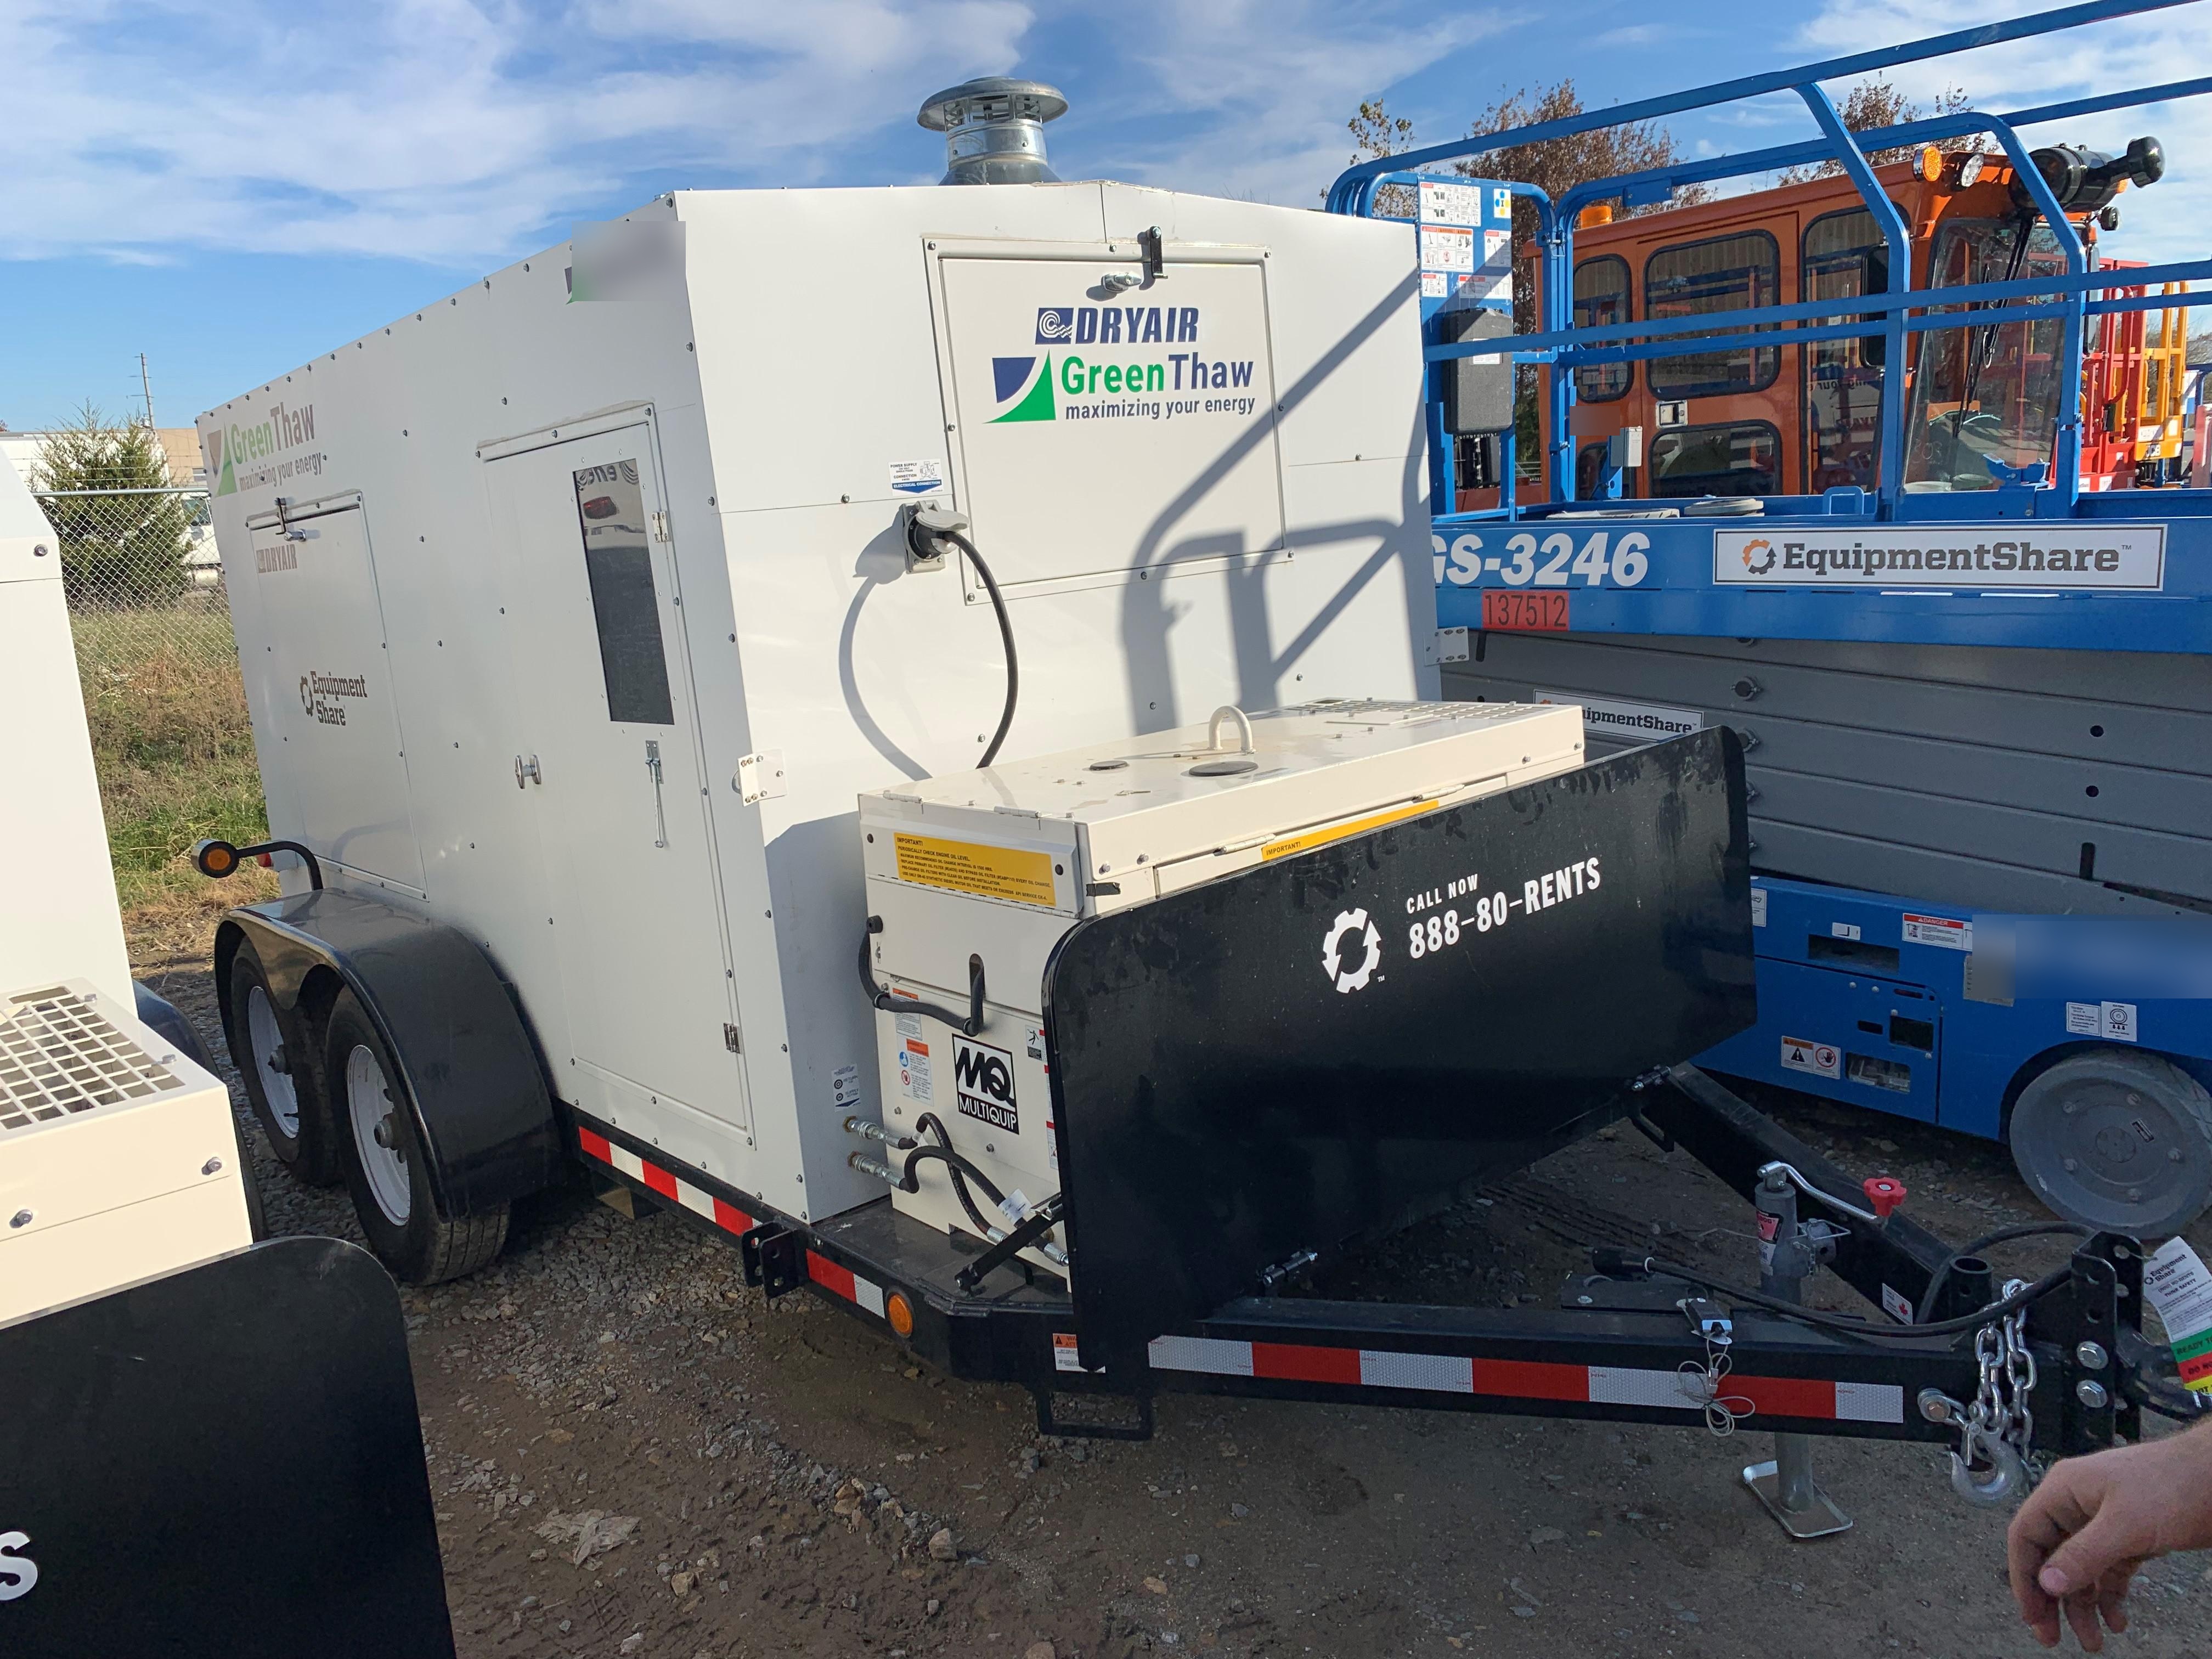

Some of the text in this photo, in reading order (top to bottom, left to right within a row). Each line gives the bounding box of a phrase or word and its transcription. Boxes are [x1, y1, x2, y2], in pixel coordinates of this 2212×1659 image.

[1075, 307, 1200, 343] DRYAIR
[1060, 352, 1254, 394] GreenThaw
[1065, 396, 1256, 420] maximizing your energy
[231, 402, 314, 465] GreenThaw
[239, 452, 321, 492] maximizing your energy
[264, 544, 298, 573] DRYAIR
[1485, 594, 1567, 628] 137512
[310, 670, 368, 702] Equipment
[316, 700, 346, 726] Share
[1265, 841, 1301, 856] IMPORTANT!
[1407, 873, 1479, 915] CALL NOW
[1409, 856, 1601, 960] 888-80-RENTS
[959, 1094, 1017, 1130] MULTIQUIP
[2150, 1253, 2187, 1277] Equipment
